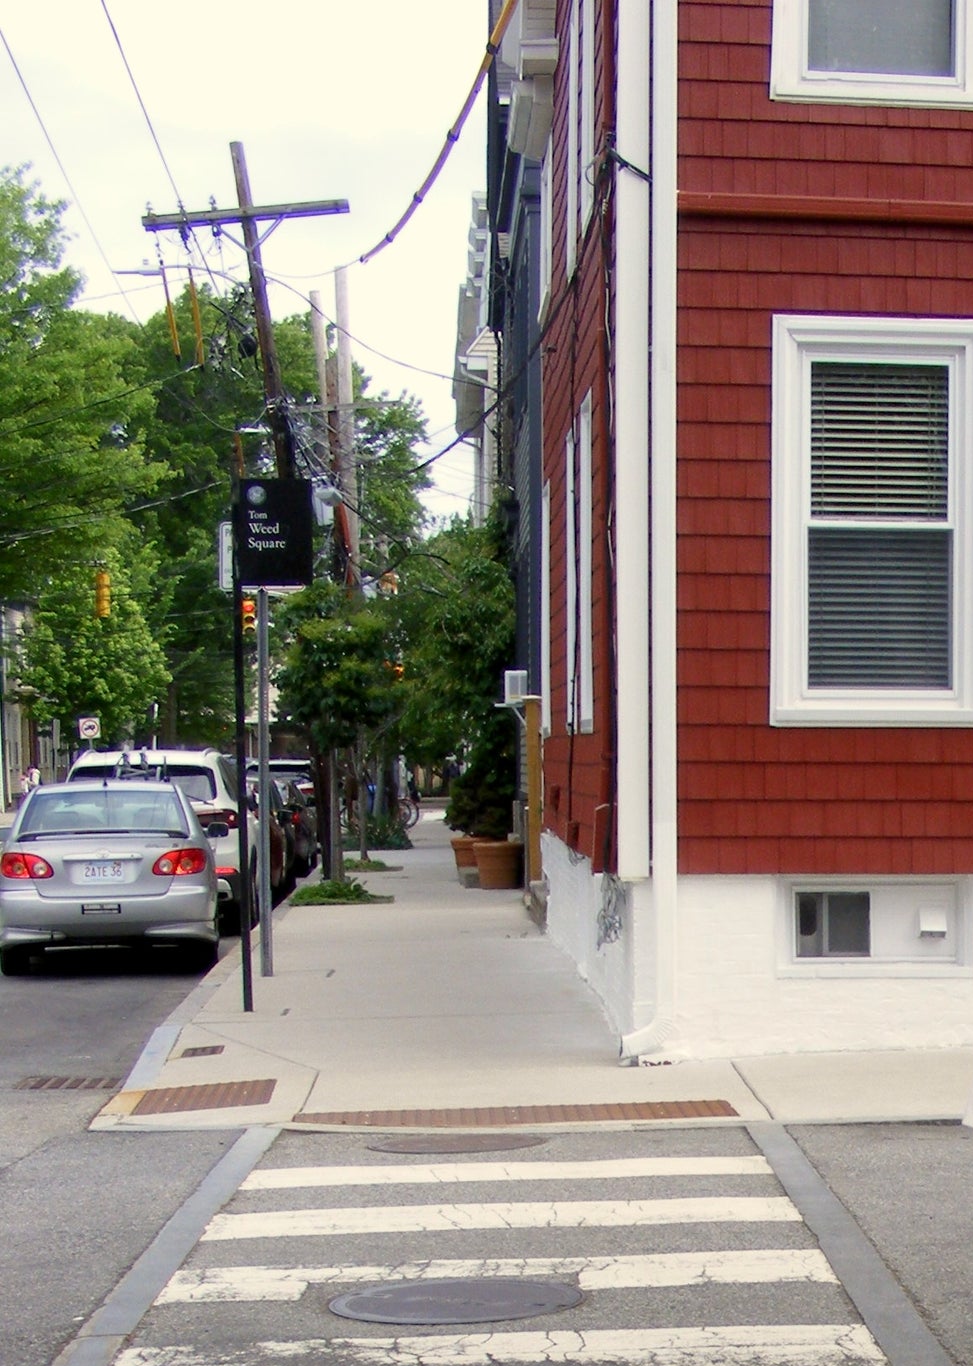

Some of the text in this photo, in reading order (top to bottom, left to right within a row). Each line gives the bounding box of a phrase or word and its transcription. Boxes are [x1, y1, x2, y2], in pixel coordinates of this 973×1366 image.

[248, 510, 268, 519] Tom
[248, 522, 280, 534] Weed
[248, 537, 286, 551] Square
